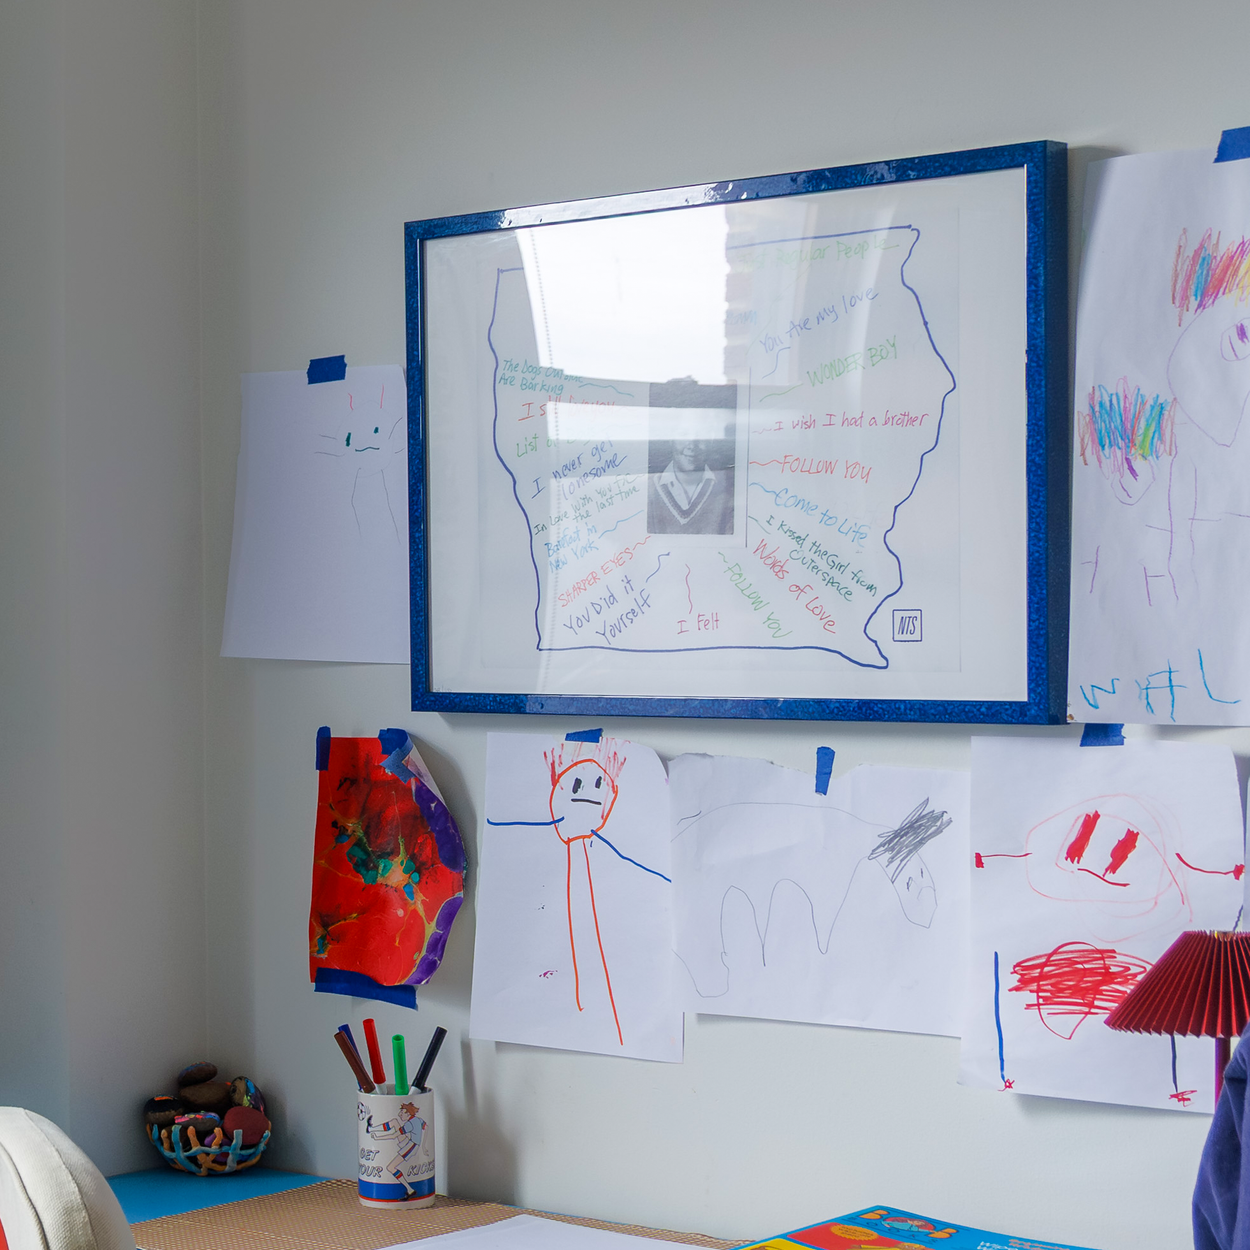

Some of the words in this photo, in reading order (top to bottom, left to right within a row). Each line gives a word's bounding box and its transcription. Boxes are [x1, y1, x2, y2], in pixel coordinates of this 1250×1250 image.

[842, 287, 879, 314] love
[502, 359, 520, 373] The
[521, 359, 542, 380] Dogs
[806, 351, 865, 387] WONDER
[867, 335, 898, 367] BOY
[499, 373, 516, 387] Are
[520, 377, 564, 395] Barking
[773, 420, 784, 431] I
[791, 414, 816, 430] wish
[822, 413, 837, 427] I
[841, 410, 864, 428] had
[868, 416, 878, 427] a
[882, 409, 930, 428] brother
[516, 433, 539, 458] List
[531, 477, 546, 500] I
[552, 452, 584, 481] never
[781, 454, 839, 475] FOLLOW
[561, 453, 628, 501] lonesome
[534, 522, 547, 536] In
[765, 515, 775, 526] I
[819, 508, 838, 527] to
[838, 518, 872, 548] Life
[571, 538, 600, 560] York
[557, 570, 601, 608] SHARPER
[600, 547, 635, 575] EYES
[621, 574, 635, 595] it
[723, 562, 770, 611] FOLLOW
[752, 538, 790, 580] Words
[789, 583, 813, 601] of
[804, 596, 837, 634] Love
[595, 588, 651, 645] Yourself
[677, 619, 689, 635] I
[696, 612, 720, 631] Felt
[898, 616, 918, 635] NTS
[359, 1147, 380, 1161] GET
